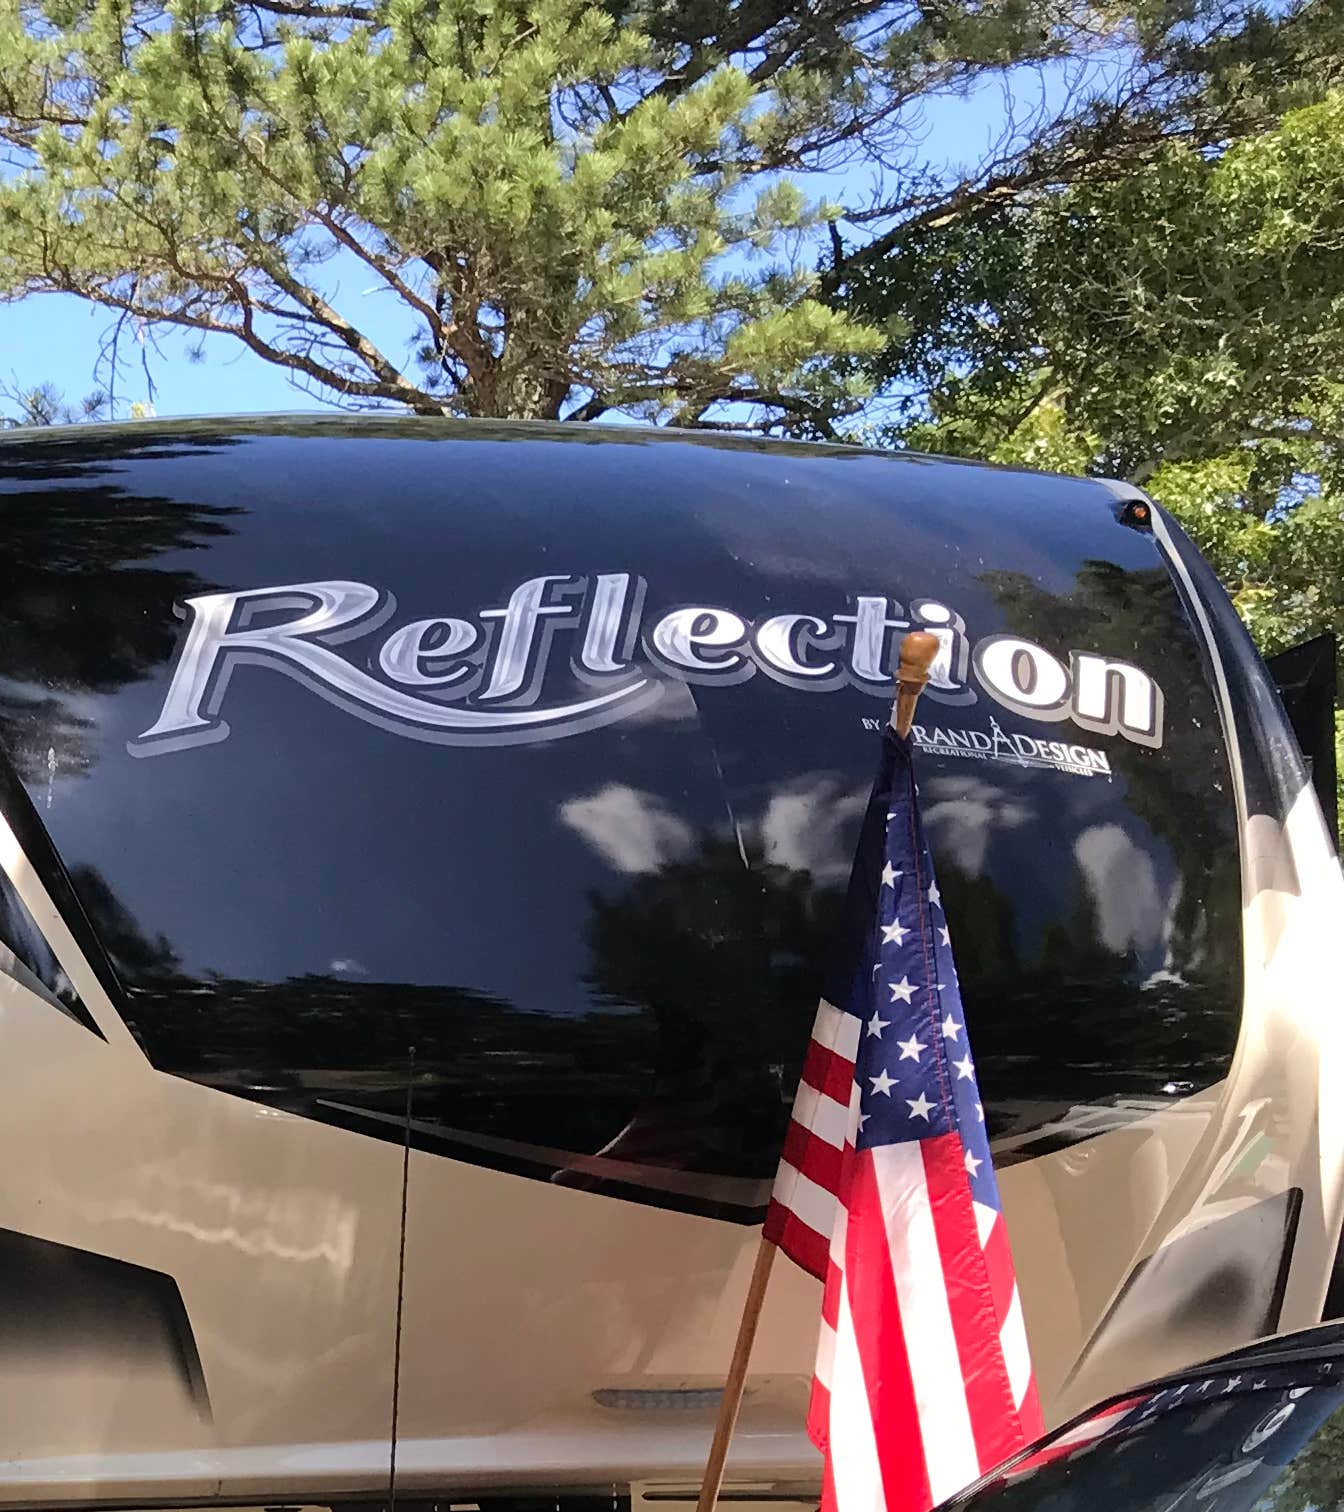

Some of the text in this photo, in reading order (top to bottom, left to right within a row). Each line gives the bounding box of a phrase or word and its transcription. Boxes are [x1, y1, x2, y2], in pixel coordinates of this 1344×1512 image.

[127, 572, 1165, 751] Reflection
[862, 717, 882, 732] BY
[1014, 733, 1112, 772] DESIGN
